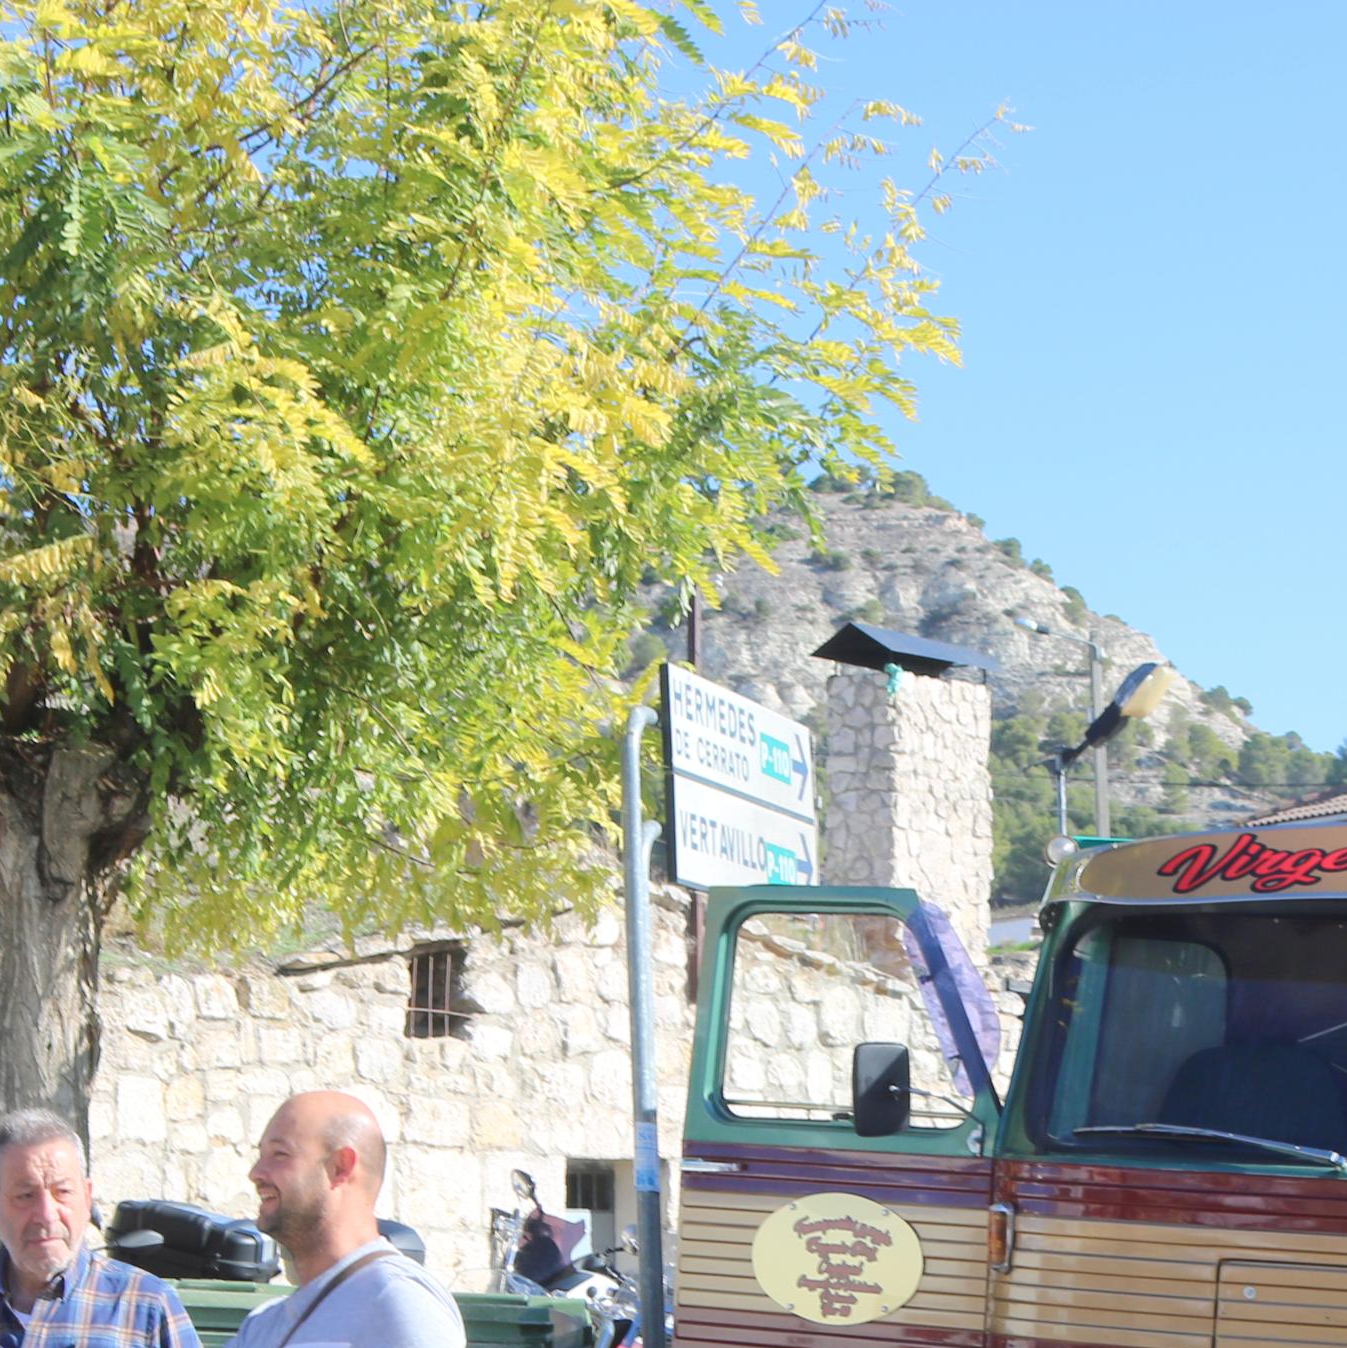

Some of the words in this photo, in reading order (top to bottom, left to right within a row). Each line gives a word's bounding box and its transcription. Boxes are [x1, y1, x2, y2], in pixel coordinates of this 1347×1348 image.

[673, 678, 756, 747] HERMEDES
[761, 740, 790, 779] P-110
[676, 728, 690, 760] DE
[697, 737, 750, 783] CERRATO
[680, 809, 767, 872] VERTAVILLO
